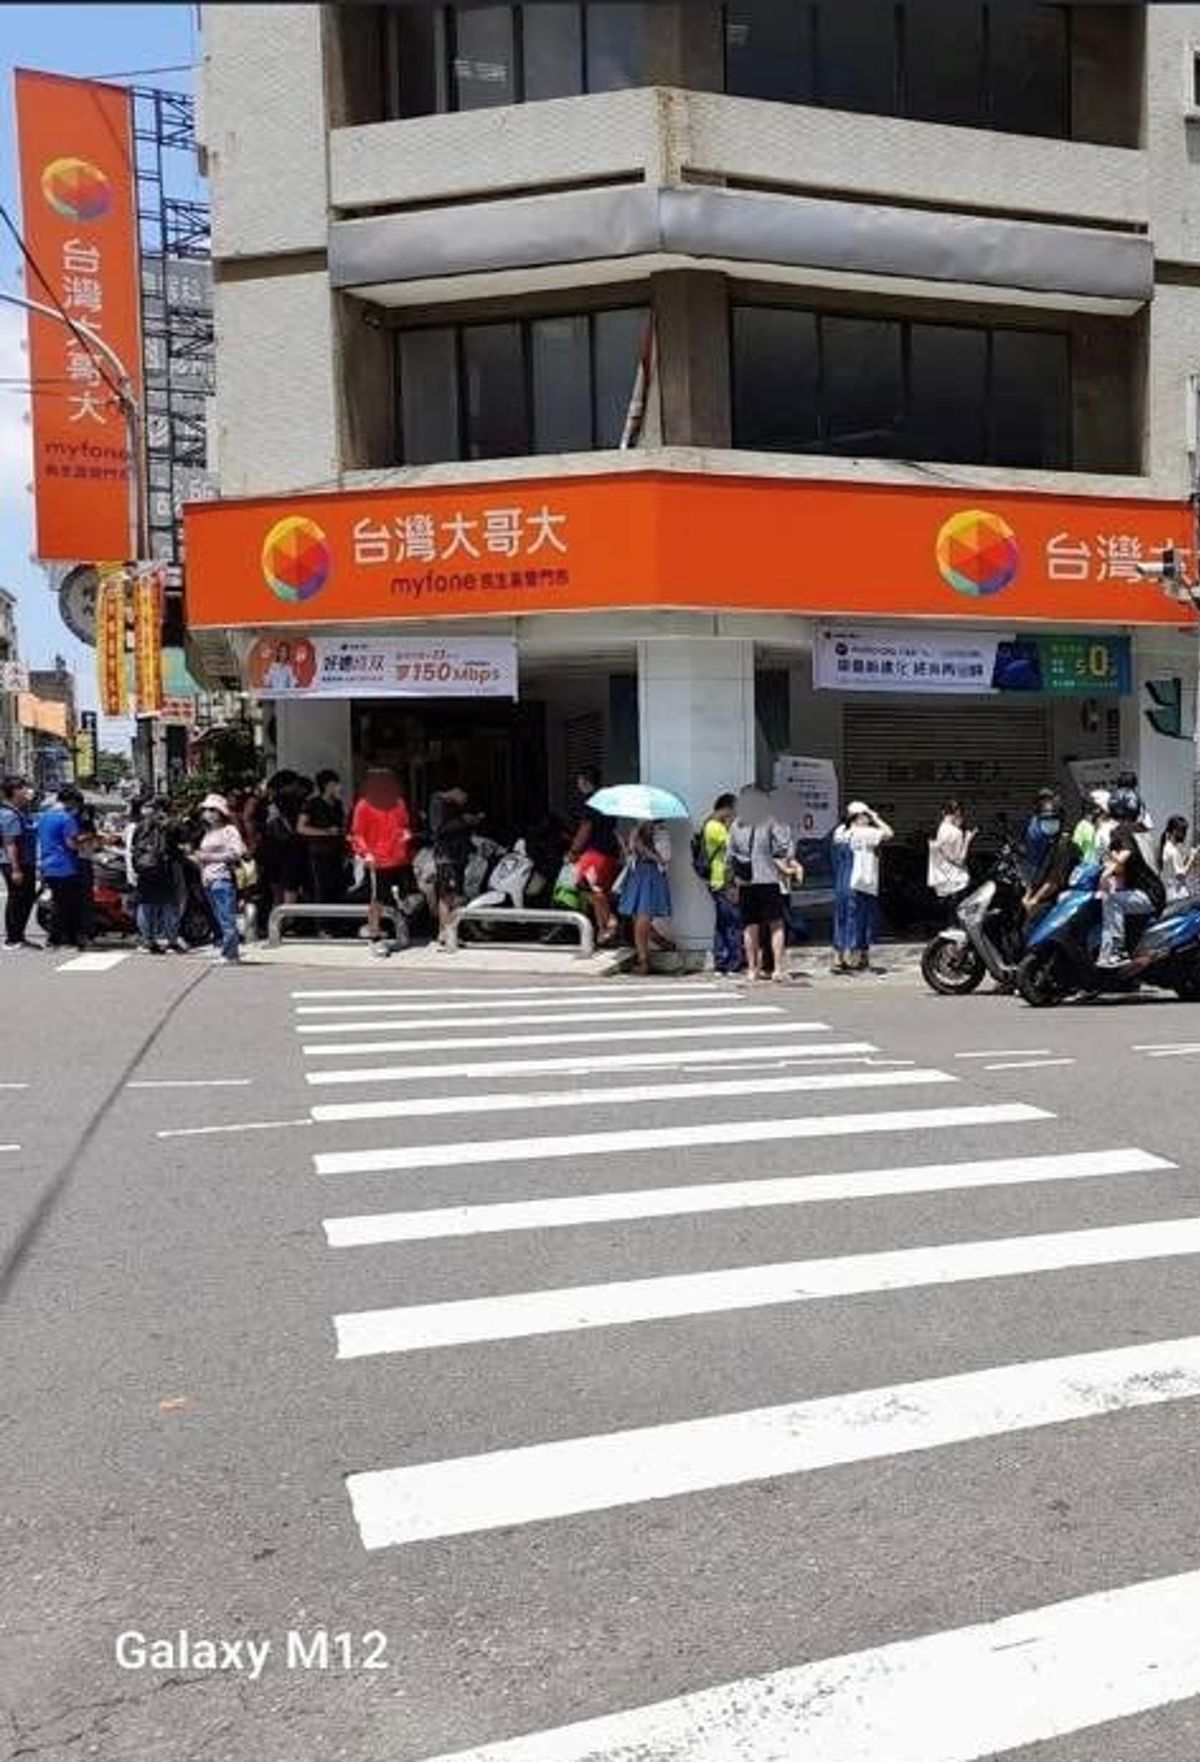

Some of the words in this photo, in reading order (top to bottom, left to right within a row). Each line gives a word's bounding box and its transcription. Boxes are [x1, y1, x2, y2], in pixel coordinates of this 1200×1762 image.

[353, 505, 568, 564] 台灣大哥大
[390, 570, 476, 600] myfone
